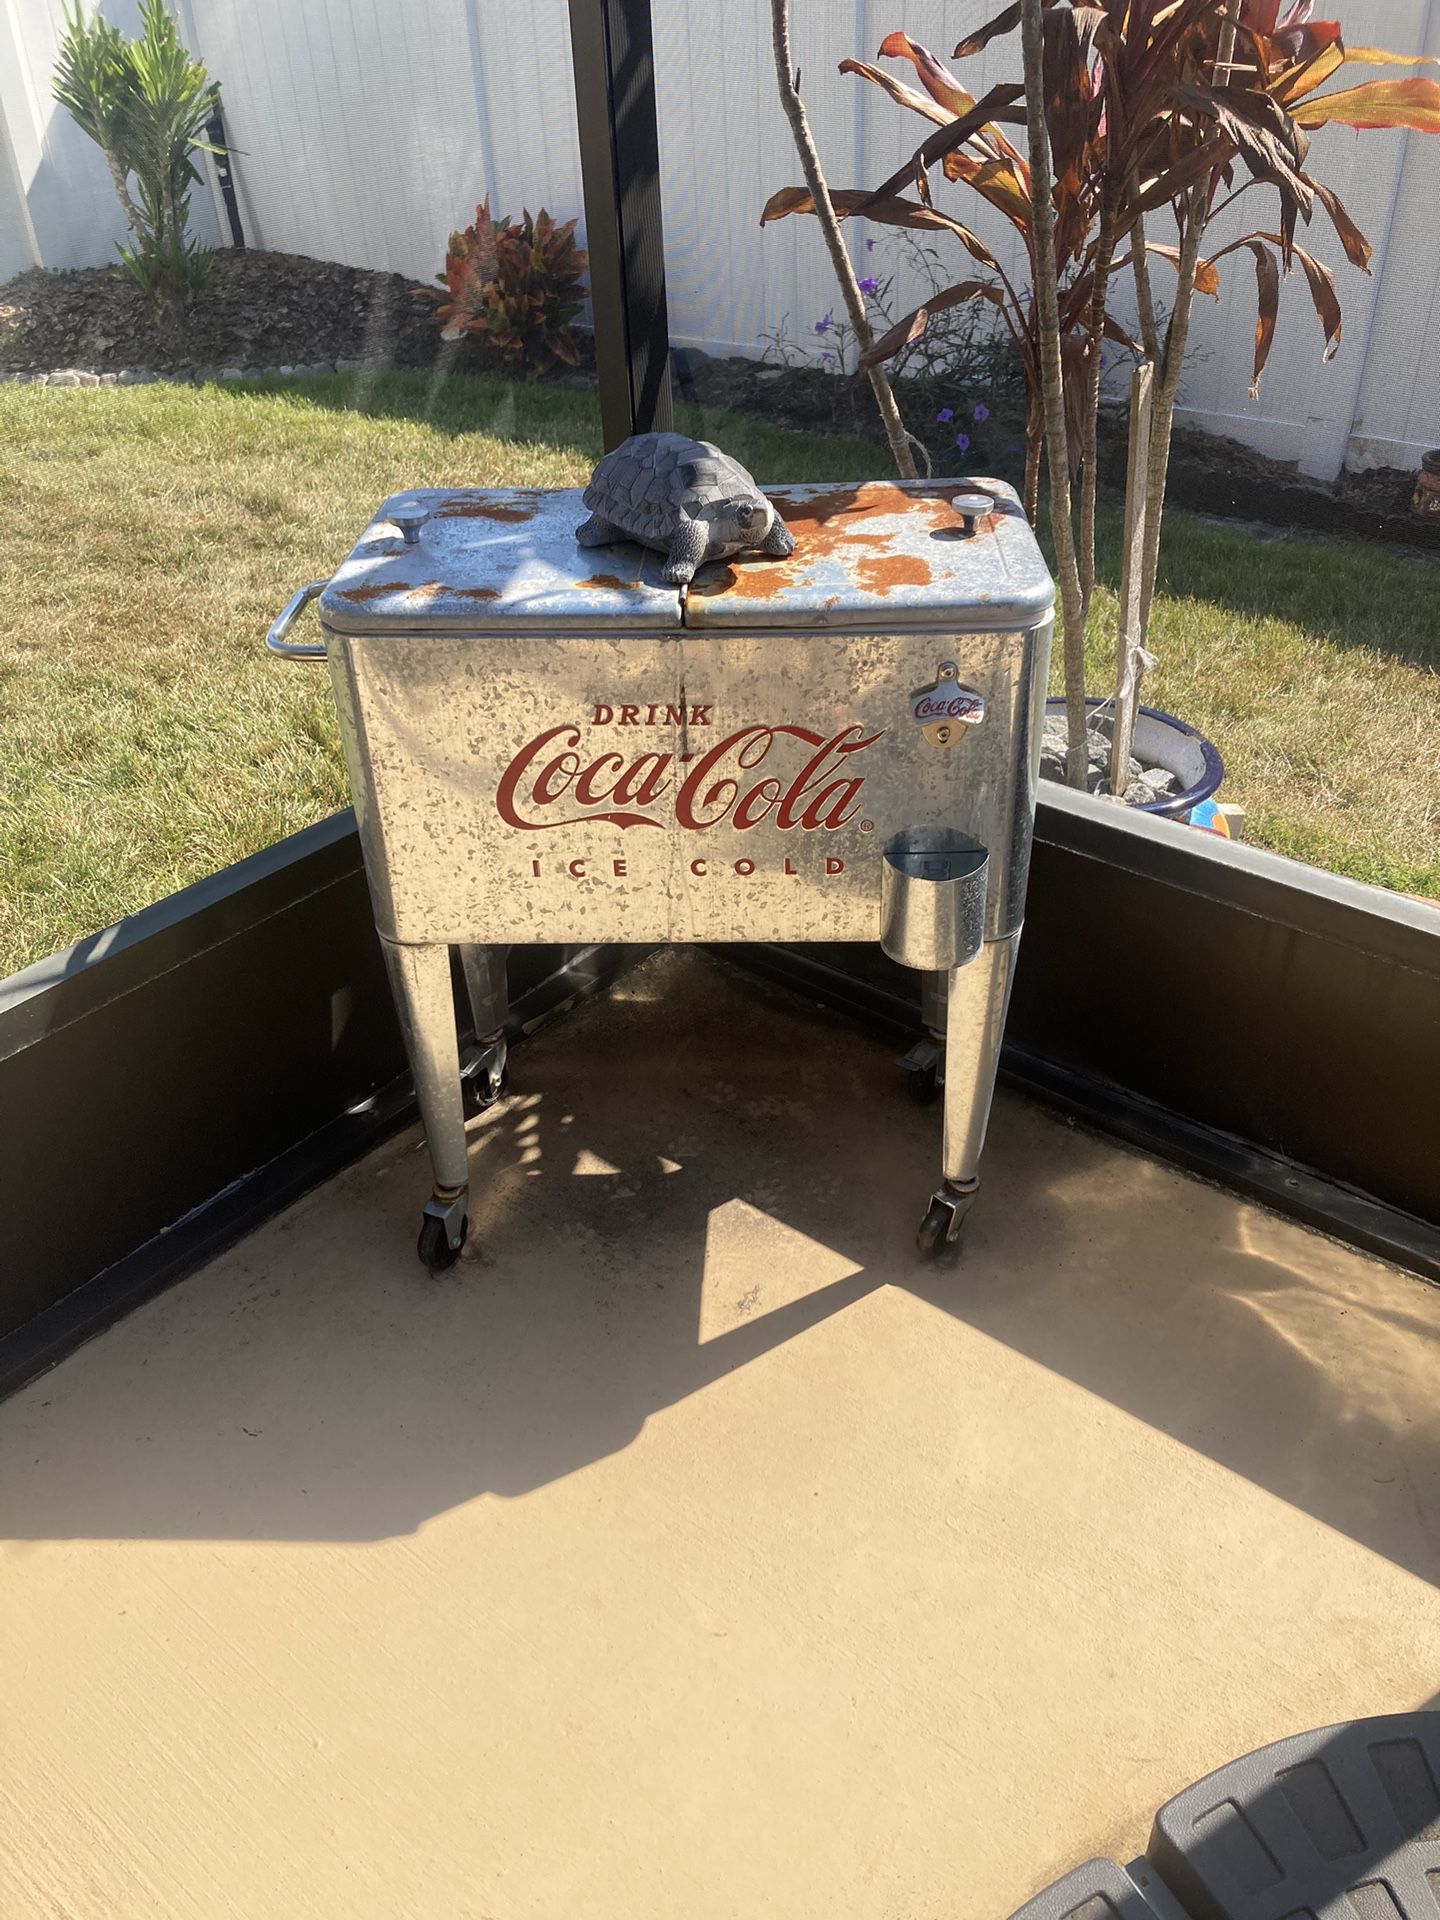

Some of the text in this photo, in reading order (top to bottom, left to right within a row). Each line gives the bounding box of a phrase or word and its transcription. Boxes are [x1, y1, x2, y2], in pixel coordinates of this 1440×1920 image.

[592, 703, 713, 726] DRINK
[496, 725, 885, 831] Coca-Cola
[532, 857, 845, 878] ICE COLD
